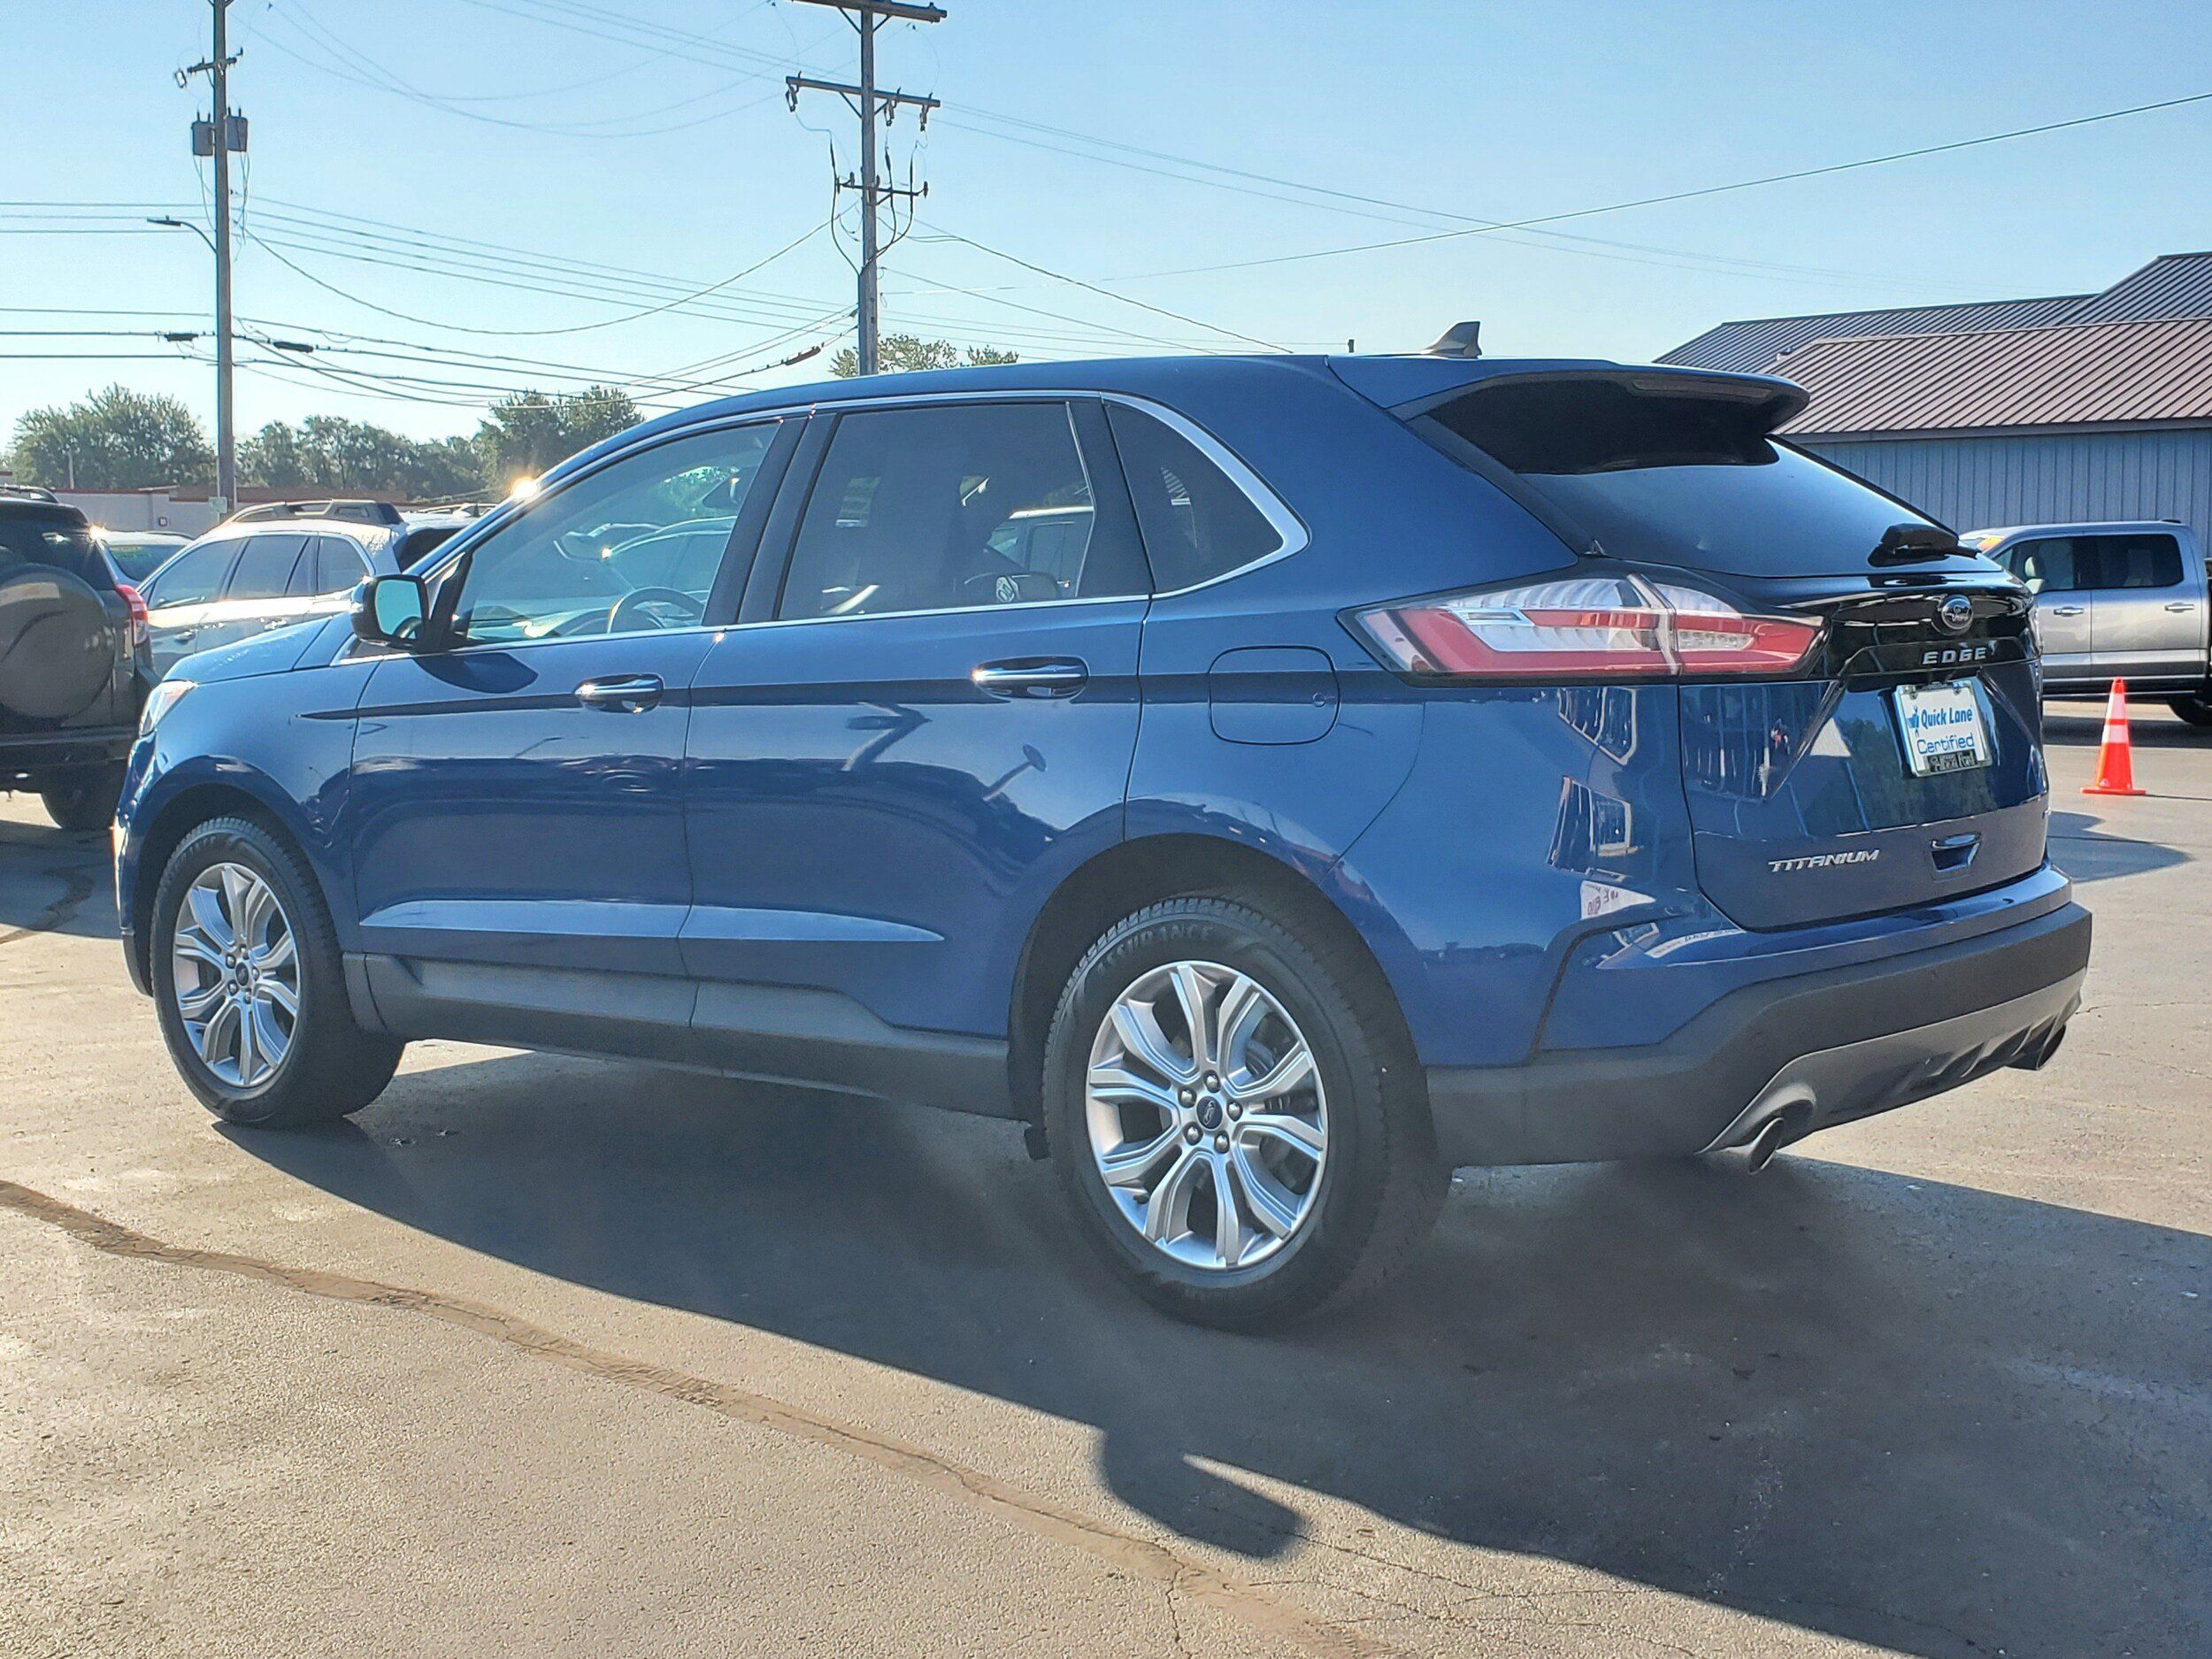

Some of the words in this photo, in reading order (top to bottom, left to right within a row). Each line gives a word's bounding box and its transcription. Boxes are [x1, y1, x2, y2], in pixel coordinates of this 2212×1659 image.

[1922, 647, 1986, 664] EDGE
[1921, 708, 1947, 729] Quick
[1949, 707, 1972, 724] Lane
[1916, 732, 1975, 754] Certified
[1768, 849, 1880, 872] TITANIUM
